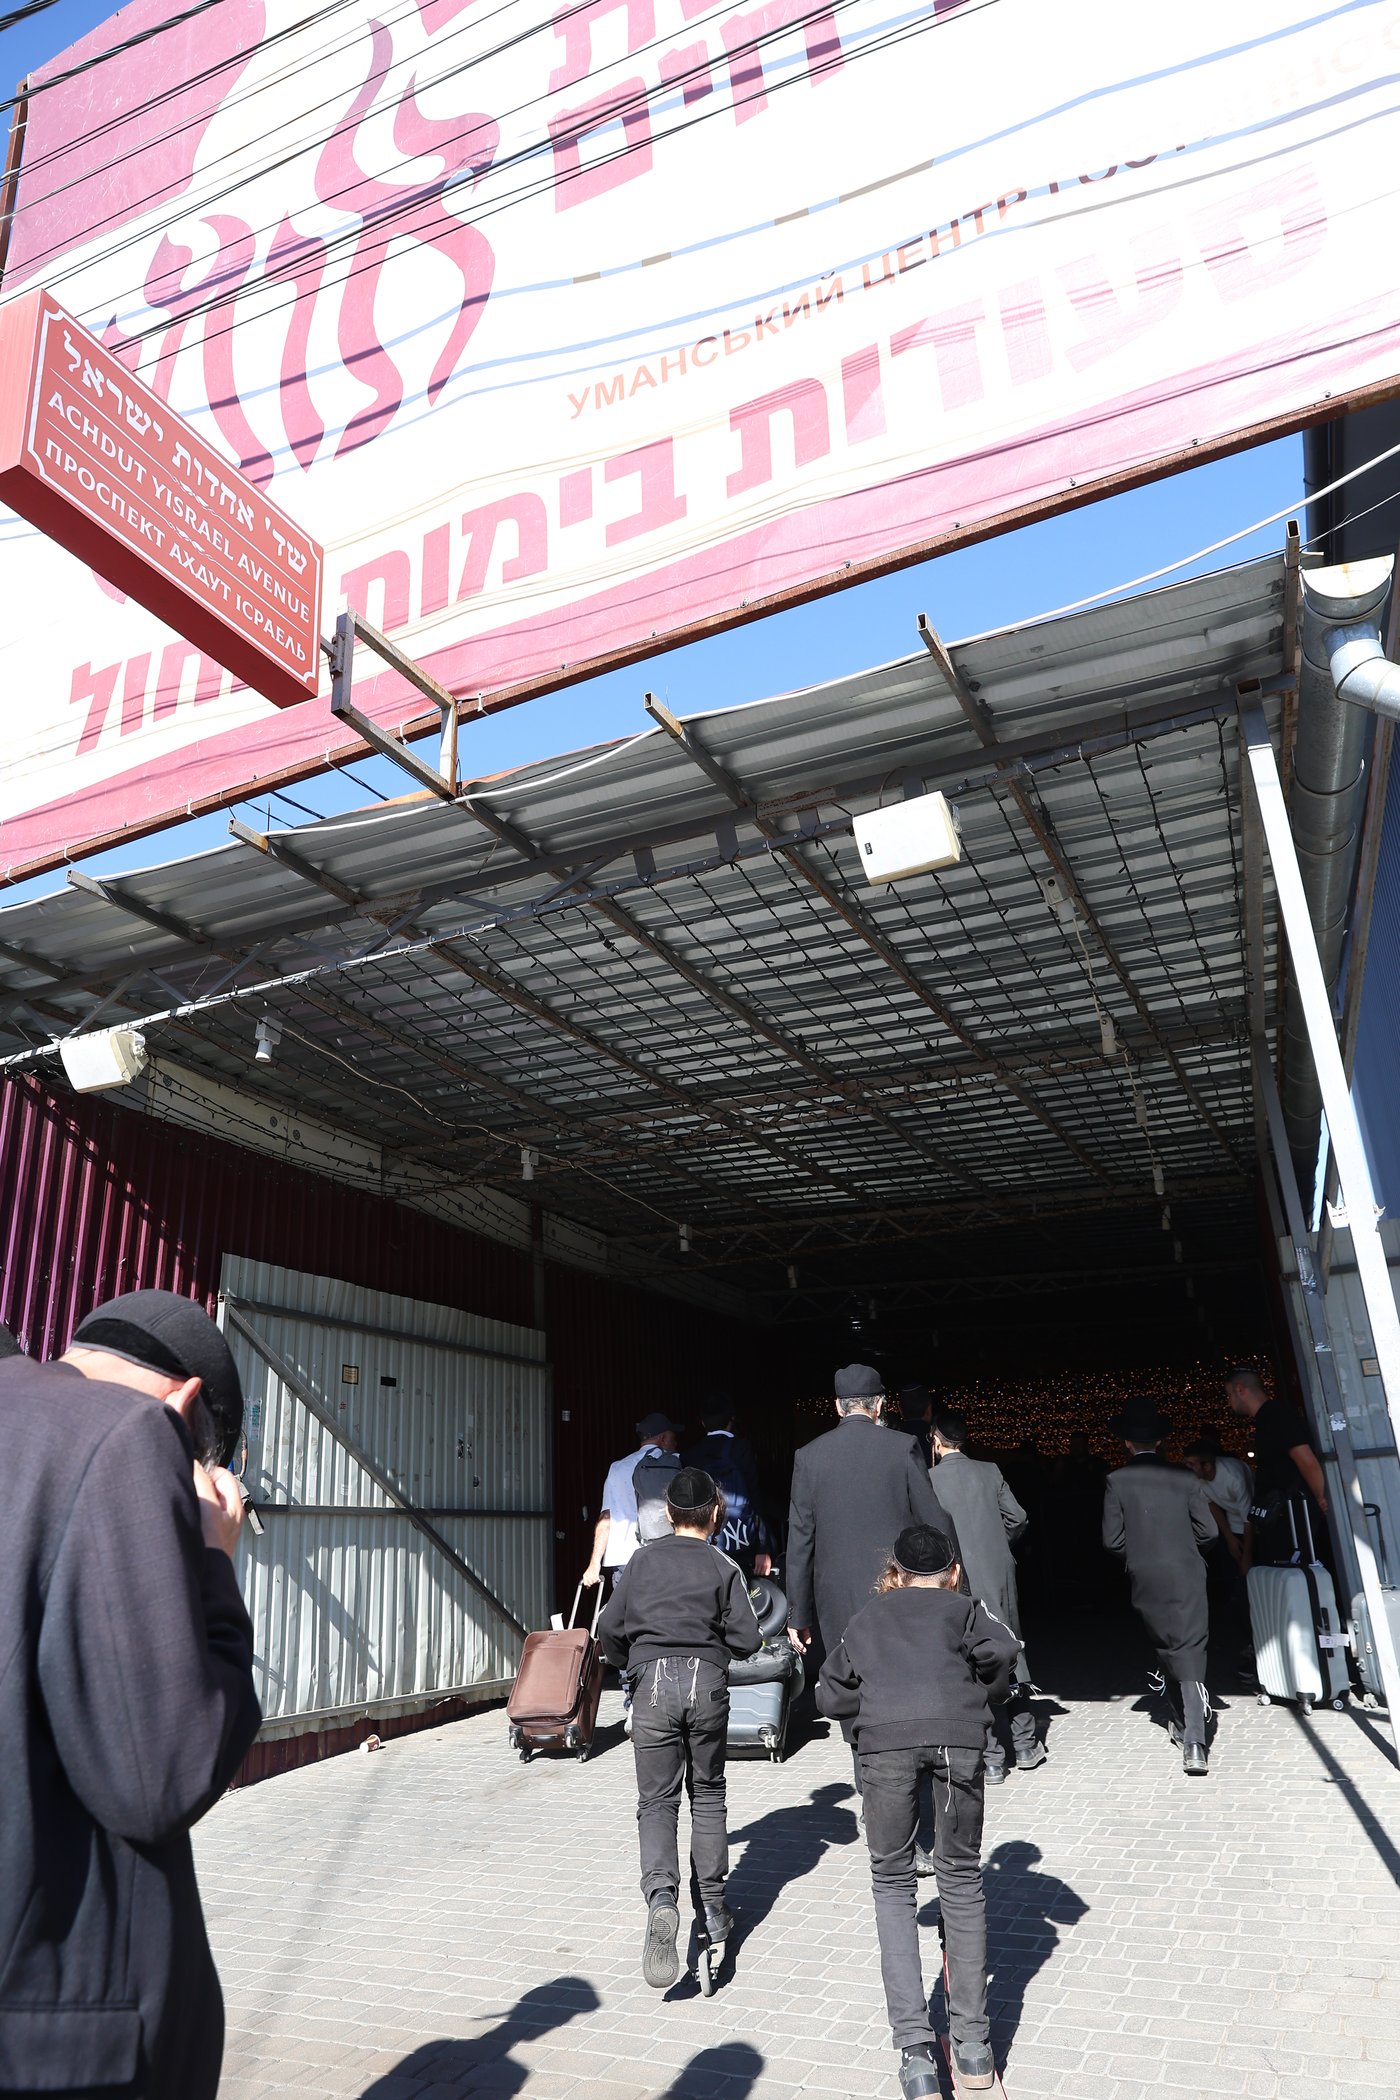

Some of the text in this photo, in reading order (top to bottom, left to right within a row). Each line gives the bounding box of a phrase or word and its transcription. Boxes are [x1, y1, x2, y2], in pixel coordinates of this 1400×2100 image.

[63, 329, 164, 442] ישראל
[567, 187, 1028, 419] УМАНСЬКИЙ ЦЕНТР
[727, 161, 1327, 498] סעודות
[45, 438, 306, 661] ПРОСПЕКТ АХДУТ ІСРАЕЛЬ
[48, 391, 310, 623] ACHDUT YISRAEL AVENUE
[172, 441, 254, 531] אחדות
[338, 435, 687, 647] בימות
[69, 639, 250, 756] חול
[723, 1518, 750, 1551] NY
